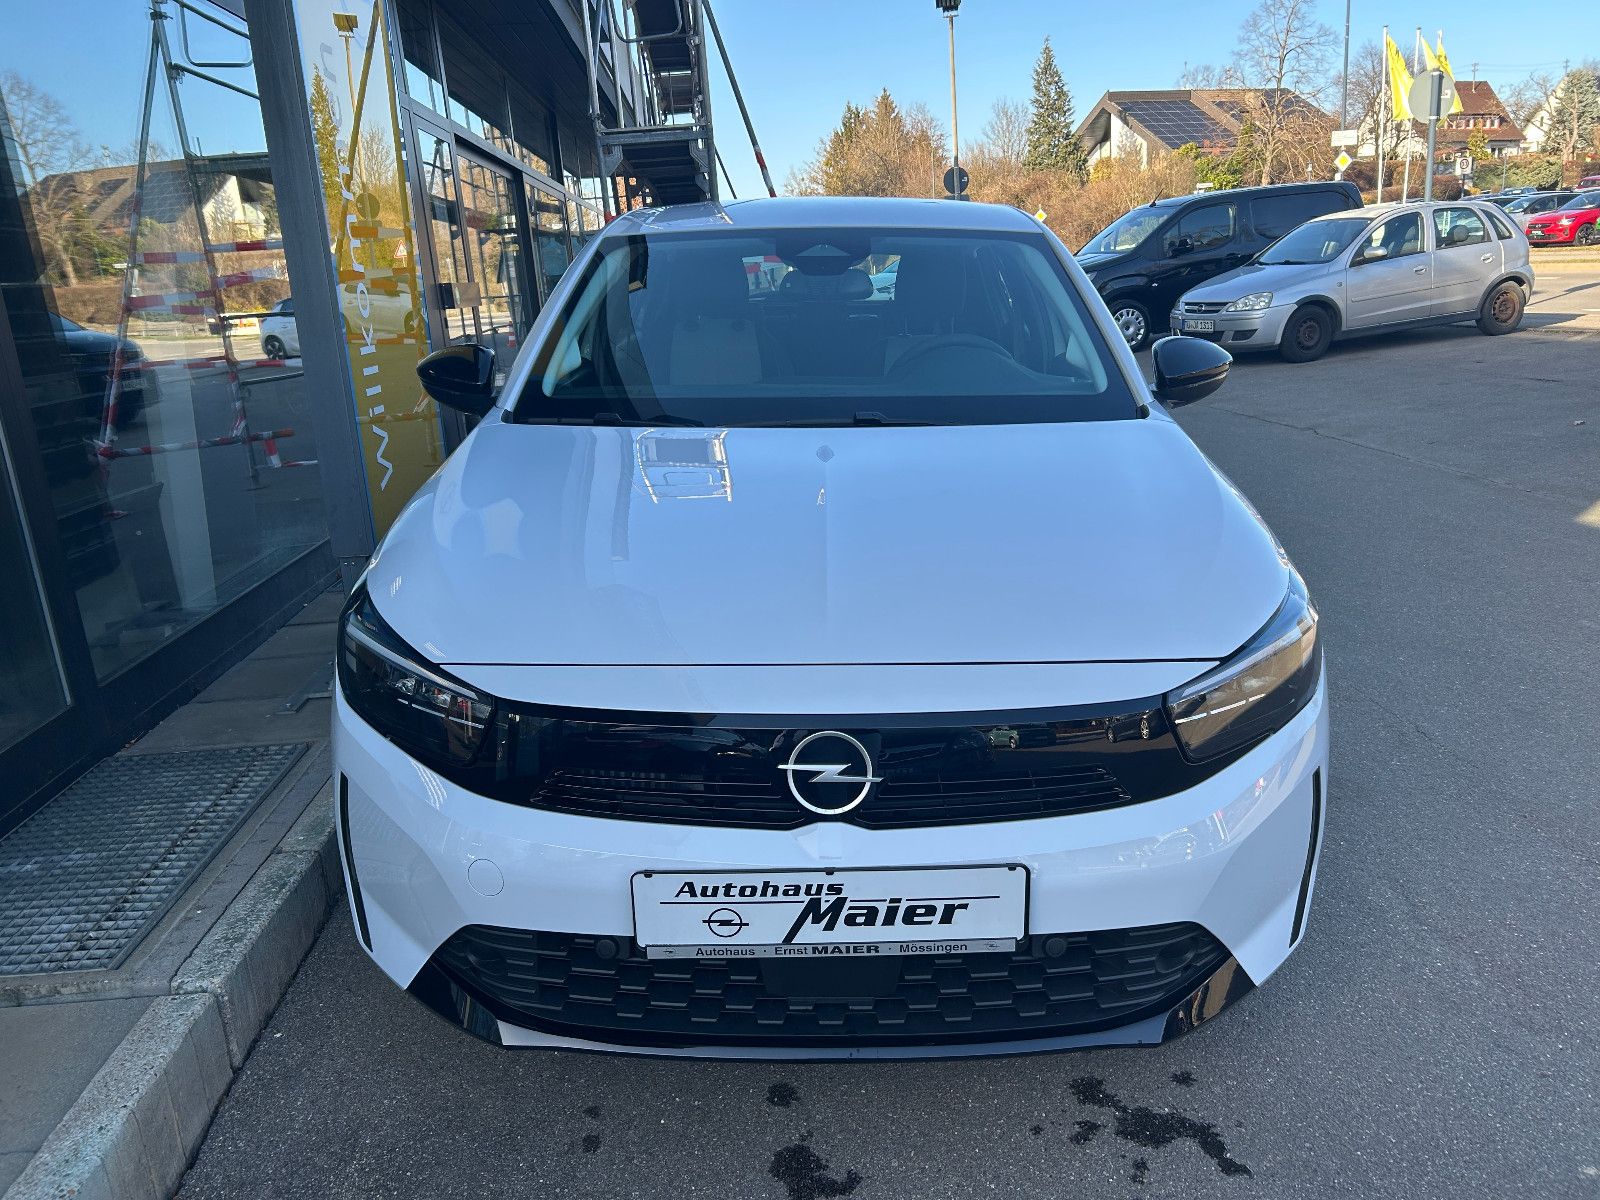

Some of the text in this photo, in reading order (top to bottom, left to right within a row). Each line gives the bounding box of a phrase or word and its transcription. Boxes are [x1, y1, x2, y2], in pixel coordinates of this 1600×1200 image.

[674, 880, 844, 898] Autohaus
[782, 896, 970, 944] Maier
[695, 943, 969, 957] Autohaus Ernst MAIER Mössingen
